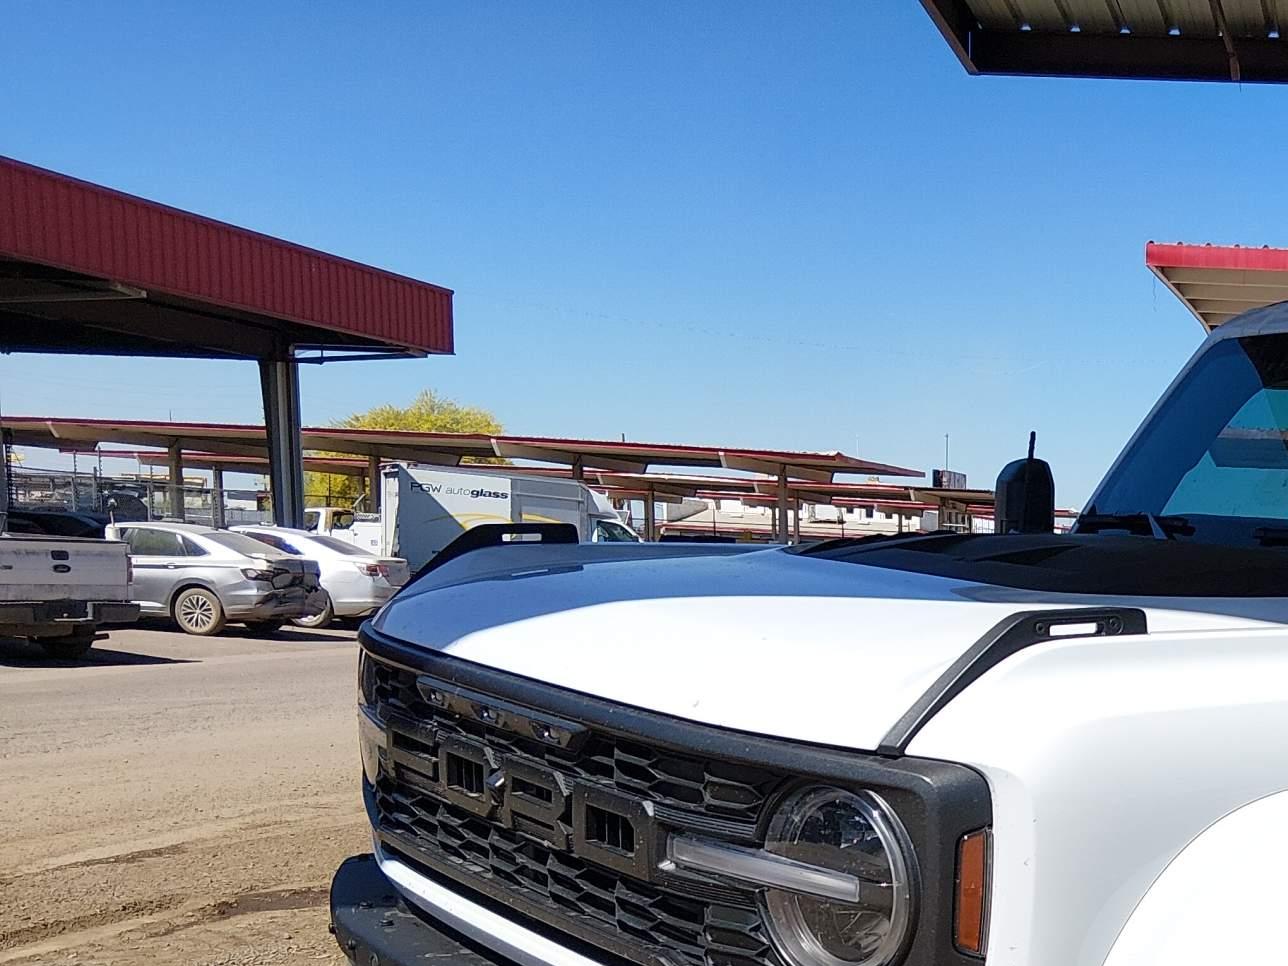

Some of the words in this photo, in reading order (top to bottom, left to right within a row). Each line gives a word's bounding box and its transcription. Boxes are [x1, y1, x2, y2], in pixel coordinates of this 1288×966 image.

[410, 481, 442, 494] PGW
[445, 486, 509, 499] autoglass
[387, 714, 656, 881] FORD
